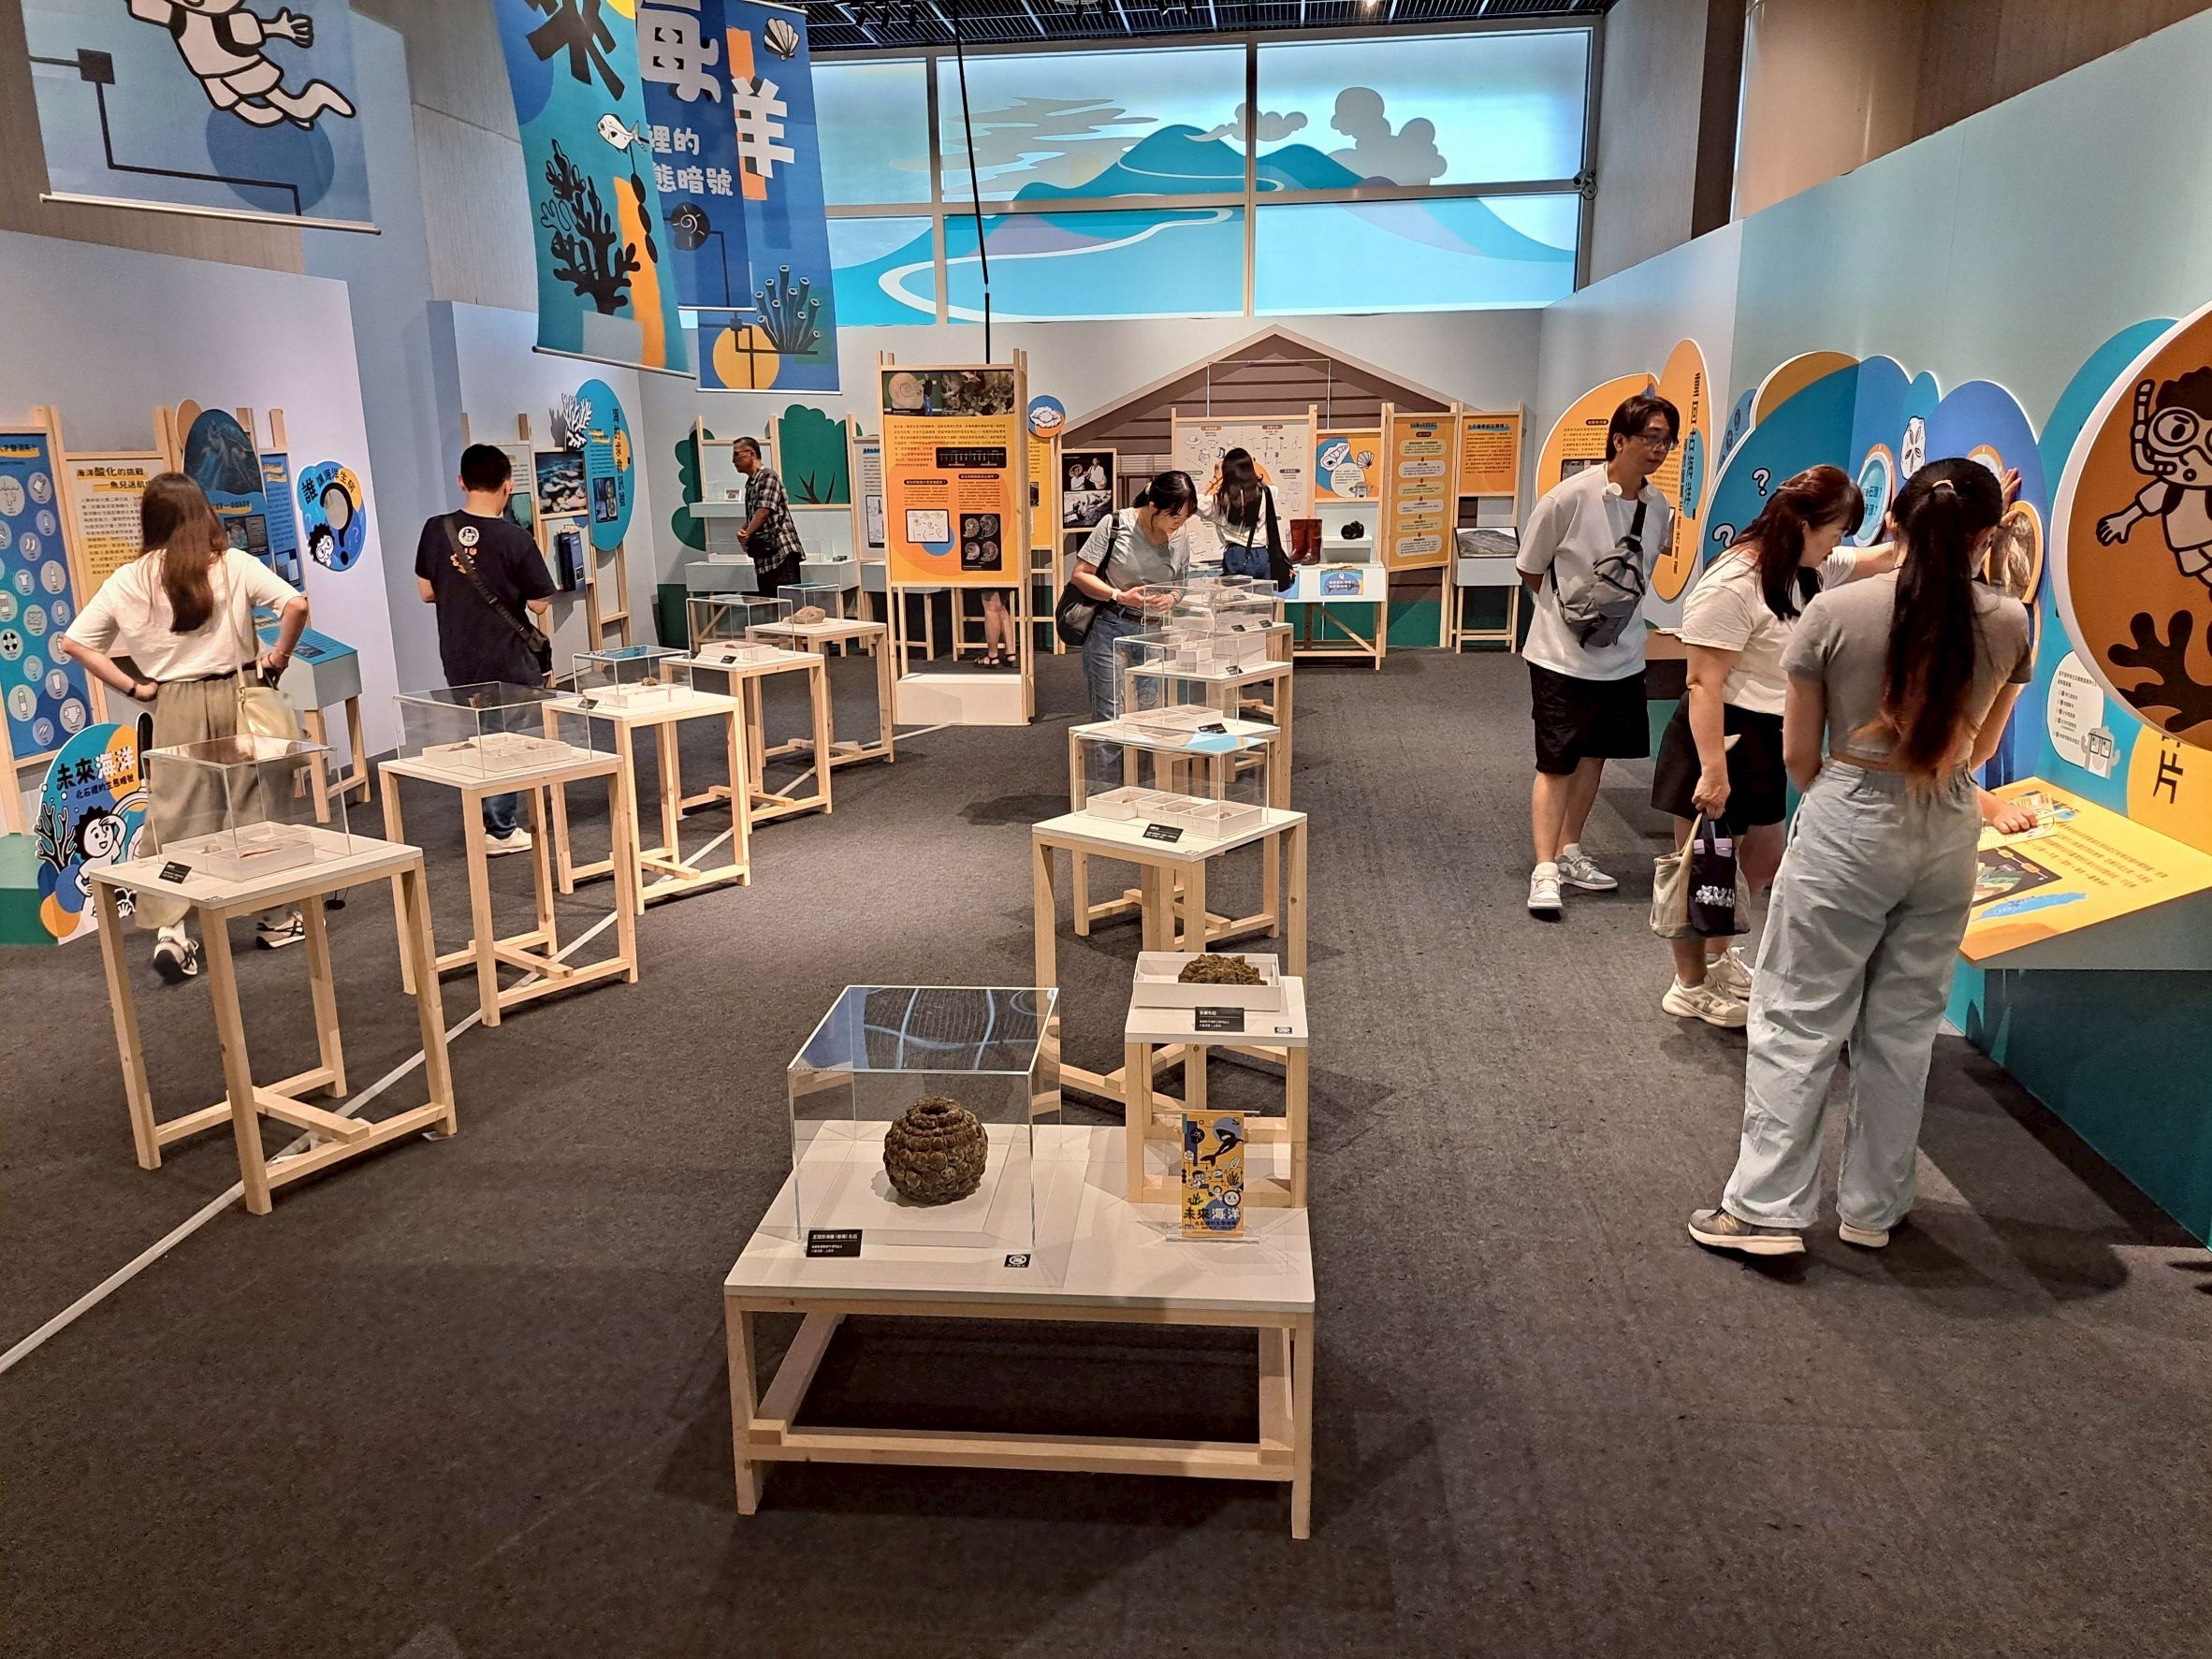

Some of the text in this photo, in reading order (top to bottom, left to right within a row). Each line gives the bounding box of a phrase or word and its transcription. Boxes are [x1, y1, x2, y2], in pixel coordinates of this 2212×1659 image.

[57, 746, 136, 791] 未來海洋
[1183, 1206, 1241, 1220] 未來海洋
